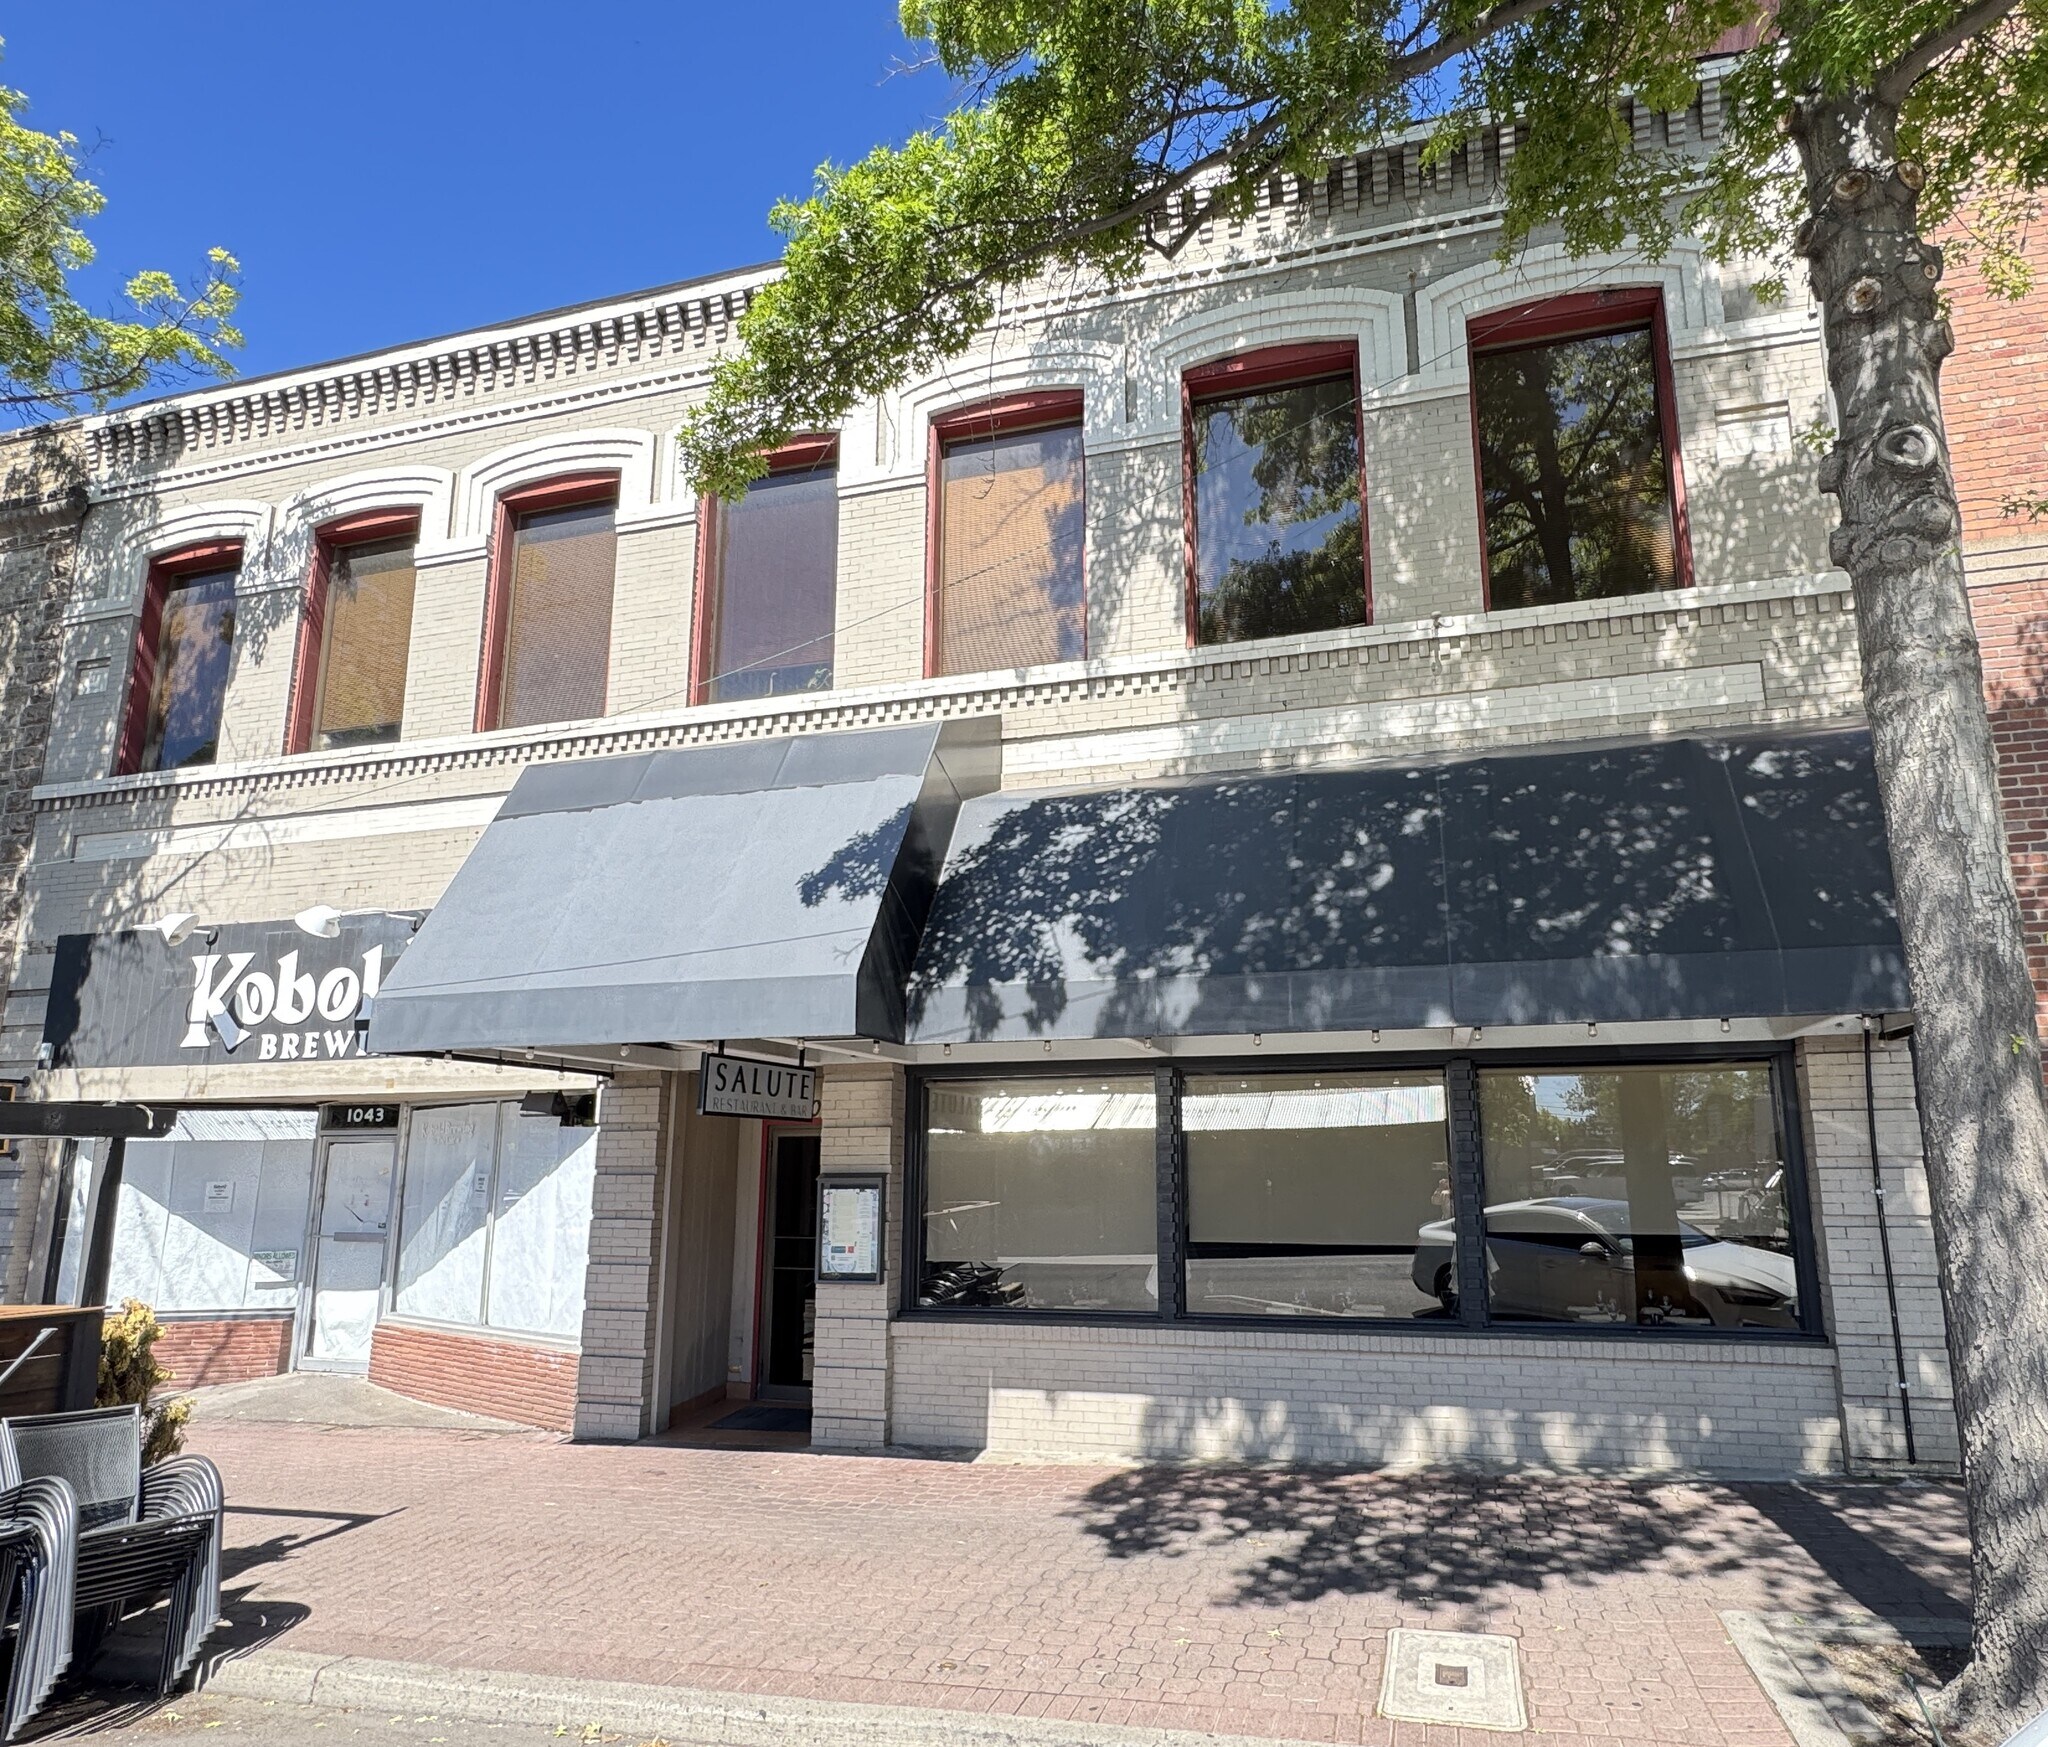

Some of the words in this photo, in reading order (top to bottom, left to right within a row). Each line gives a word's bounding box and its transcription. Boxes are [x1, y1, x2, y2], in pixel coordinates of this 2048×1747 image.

[258, 1030, 379, 1060] BREWI
[715, 1063, 810, 1100] SALUTE
[347, 1107, 385, 1122] 1043
[712, 1096, 776, 1115] RESTAURANT
[780, 1104, 788, 1115] &
[790, 1104, 808, 1117] BAR
